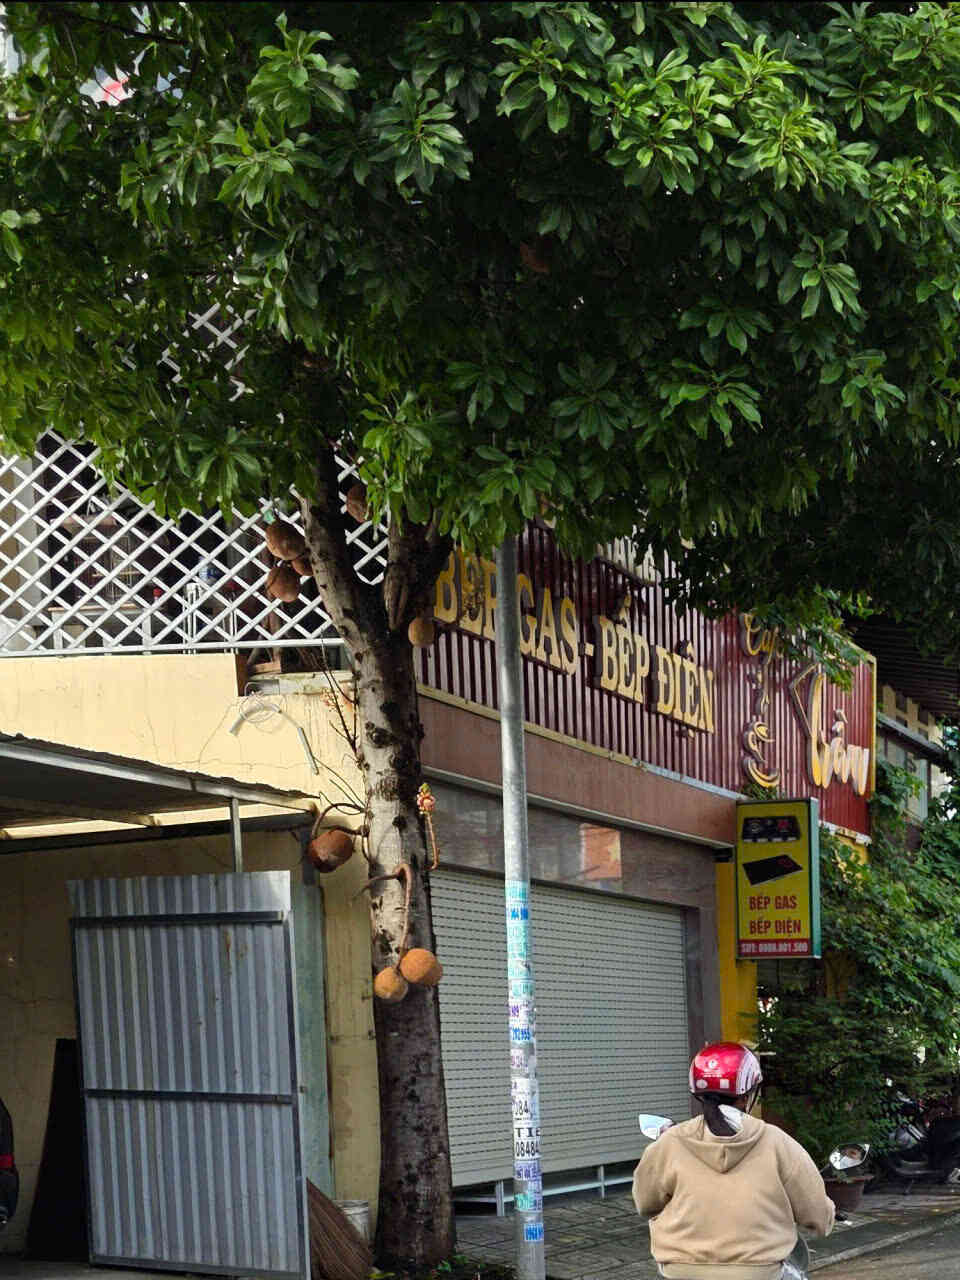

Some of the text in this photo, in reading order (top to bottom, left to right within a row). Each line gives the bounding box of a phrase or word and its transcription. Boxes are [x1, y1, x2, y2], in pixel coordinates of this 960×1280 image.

[600, 594, 650, 704] BẾP
[656, 639, 714, 738] ĐIỆN
[749, 892, 797, 911] BẾP GAS
[750, 914, 771, 934] BẾP
